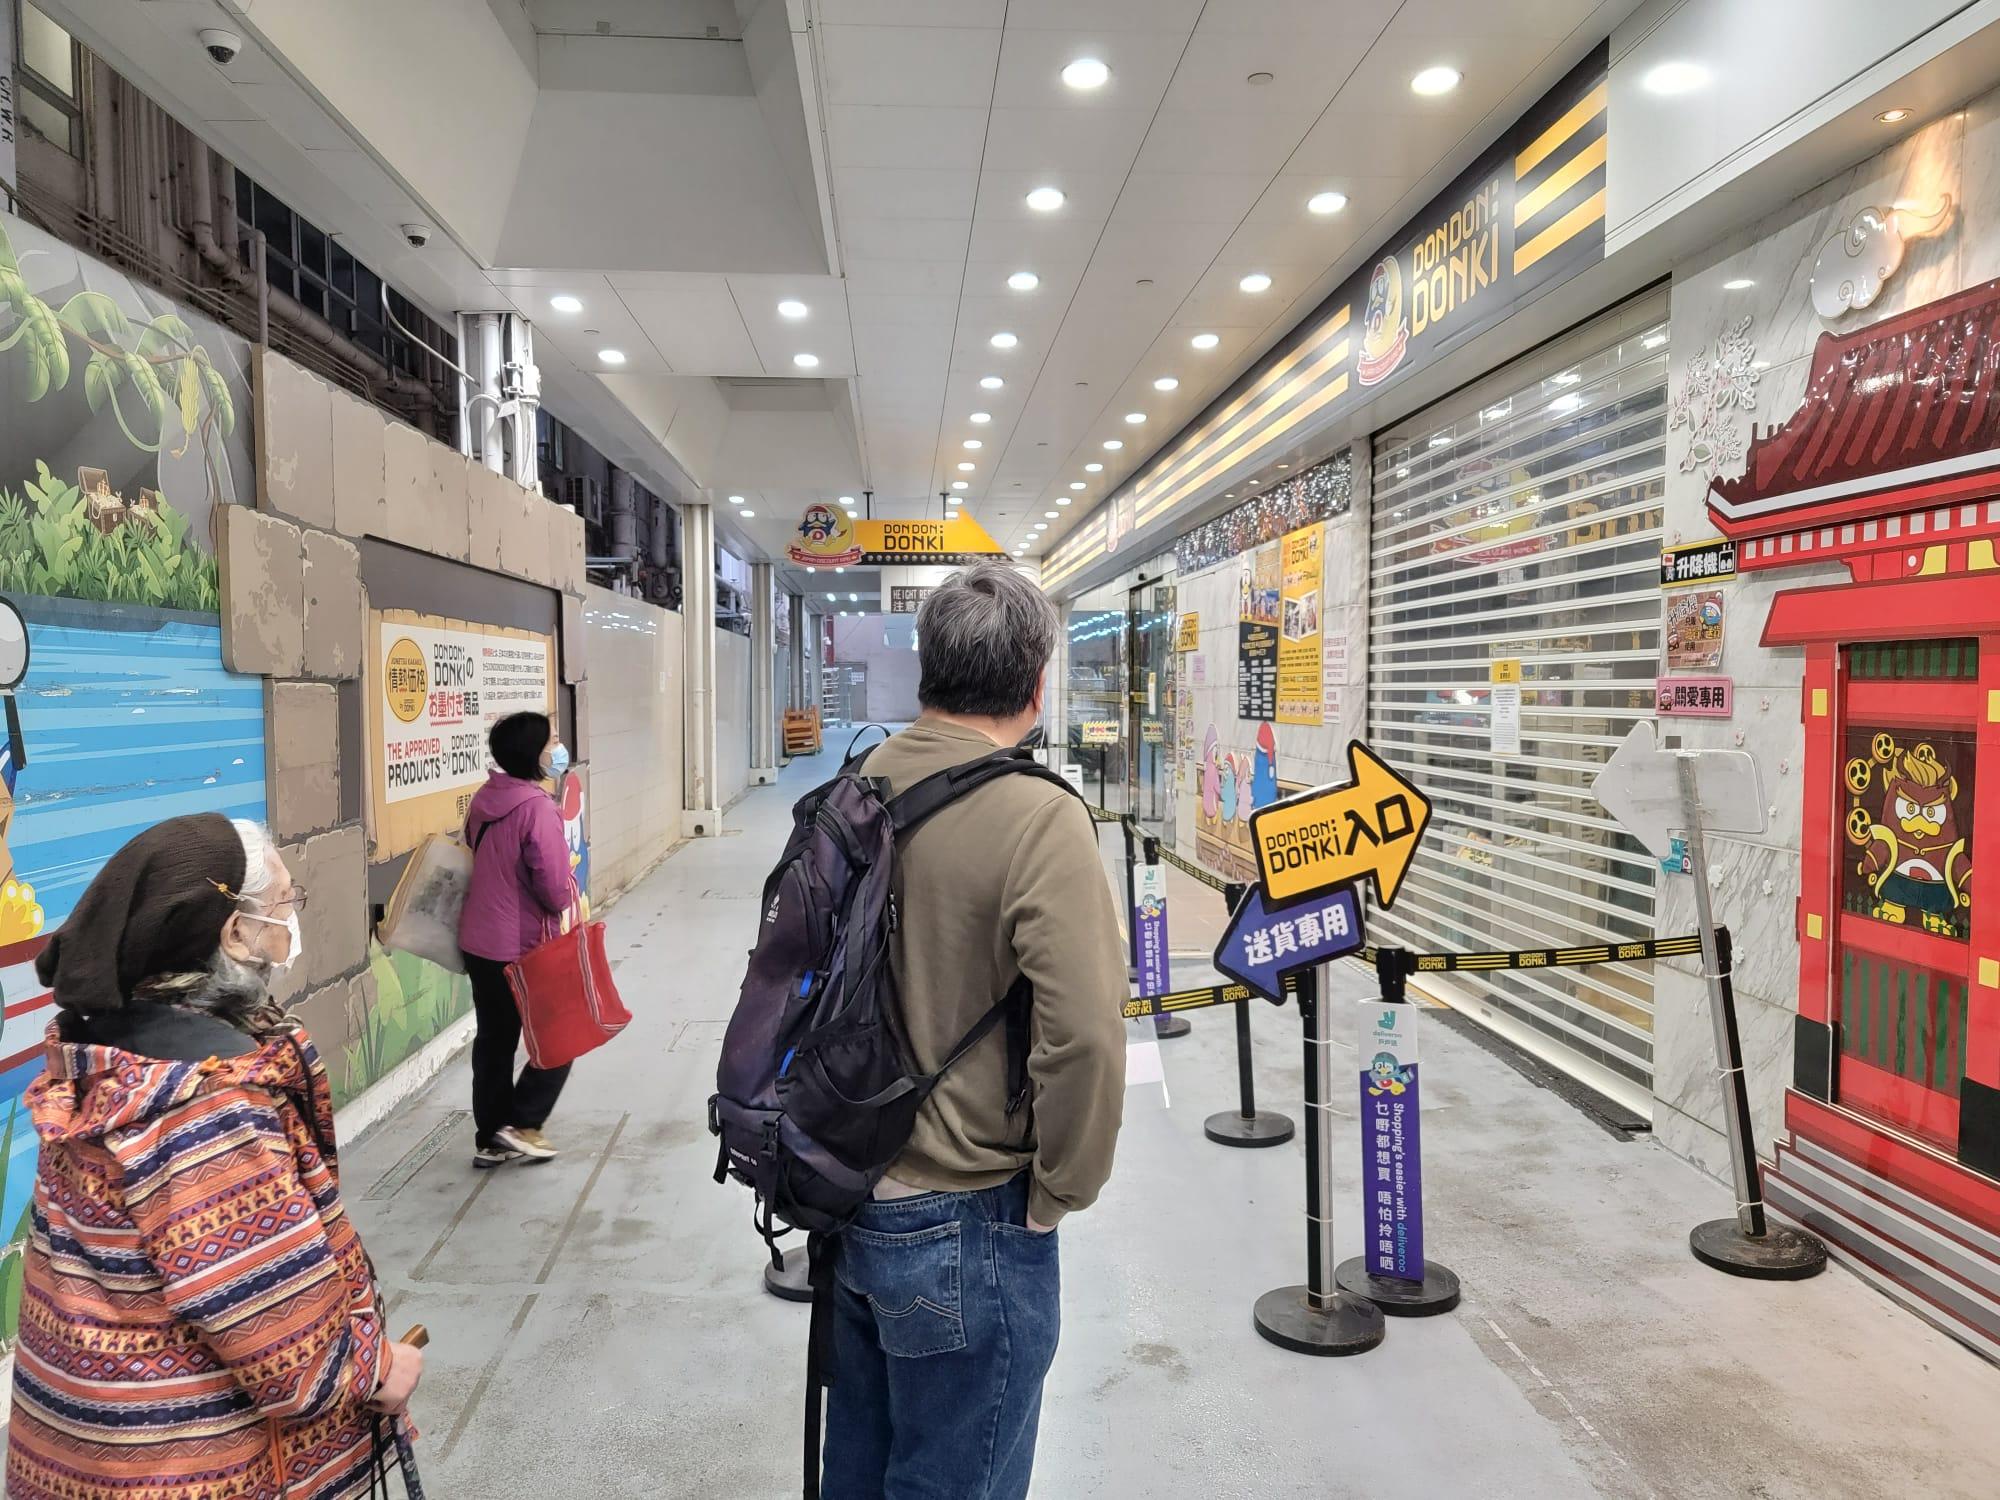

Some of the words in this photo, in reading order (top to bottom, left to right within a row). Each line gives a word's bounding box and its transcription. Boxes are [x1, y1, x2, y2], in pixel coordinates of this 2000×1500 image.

[1412, 222, 1499, 338] DONKI
[884, 535, 944, 550] DONKI
[1676, 551, 1718, 579] 升降機
[434, 661, 466, 687] DONKI
[1674, 686, 1725, 709] 關愛專用
[387, 742, 402, 761] THE
[404, 737, 441, 759] APPROVED
[388, 756, 441, 789] PRODUCTS
[442, 746, 450, 770] by
[452, 750, 480, 775] DONKI
[1269, 834, 1341, 874] DONKI
[1344, 793, 1415, 856] 入口
[1243, 903, 1349, 967] 送貨專用
[1418, 961, 1447, 970] DONKI
[1519, 957, 1547, 967] DONKI
[1618, 949, 1646, 959] DONKI
[1222, 989, 1249, 1001] DONKI
[1391, 1102, 1406, 1160] Shopping's
[1395, 1162, 1407, 1196] easier
[1396, 1197, 1408, 1220] with
[1397, 1222, 1409, 1273] deliveroo
